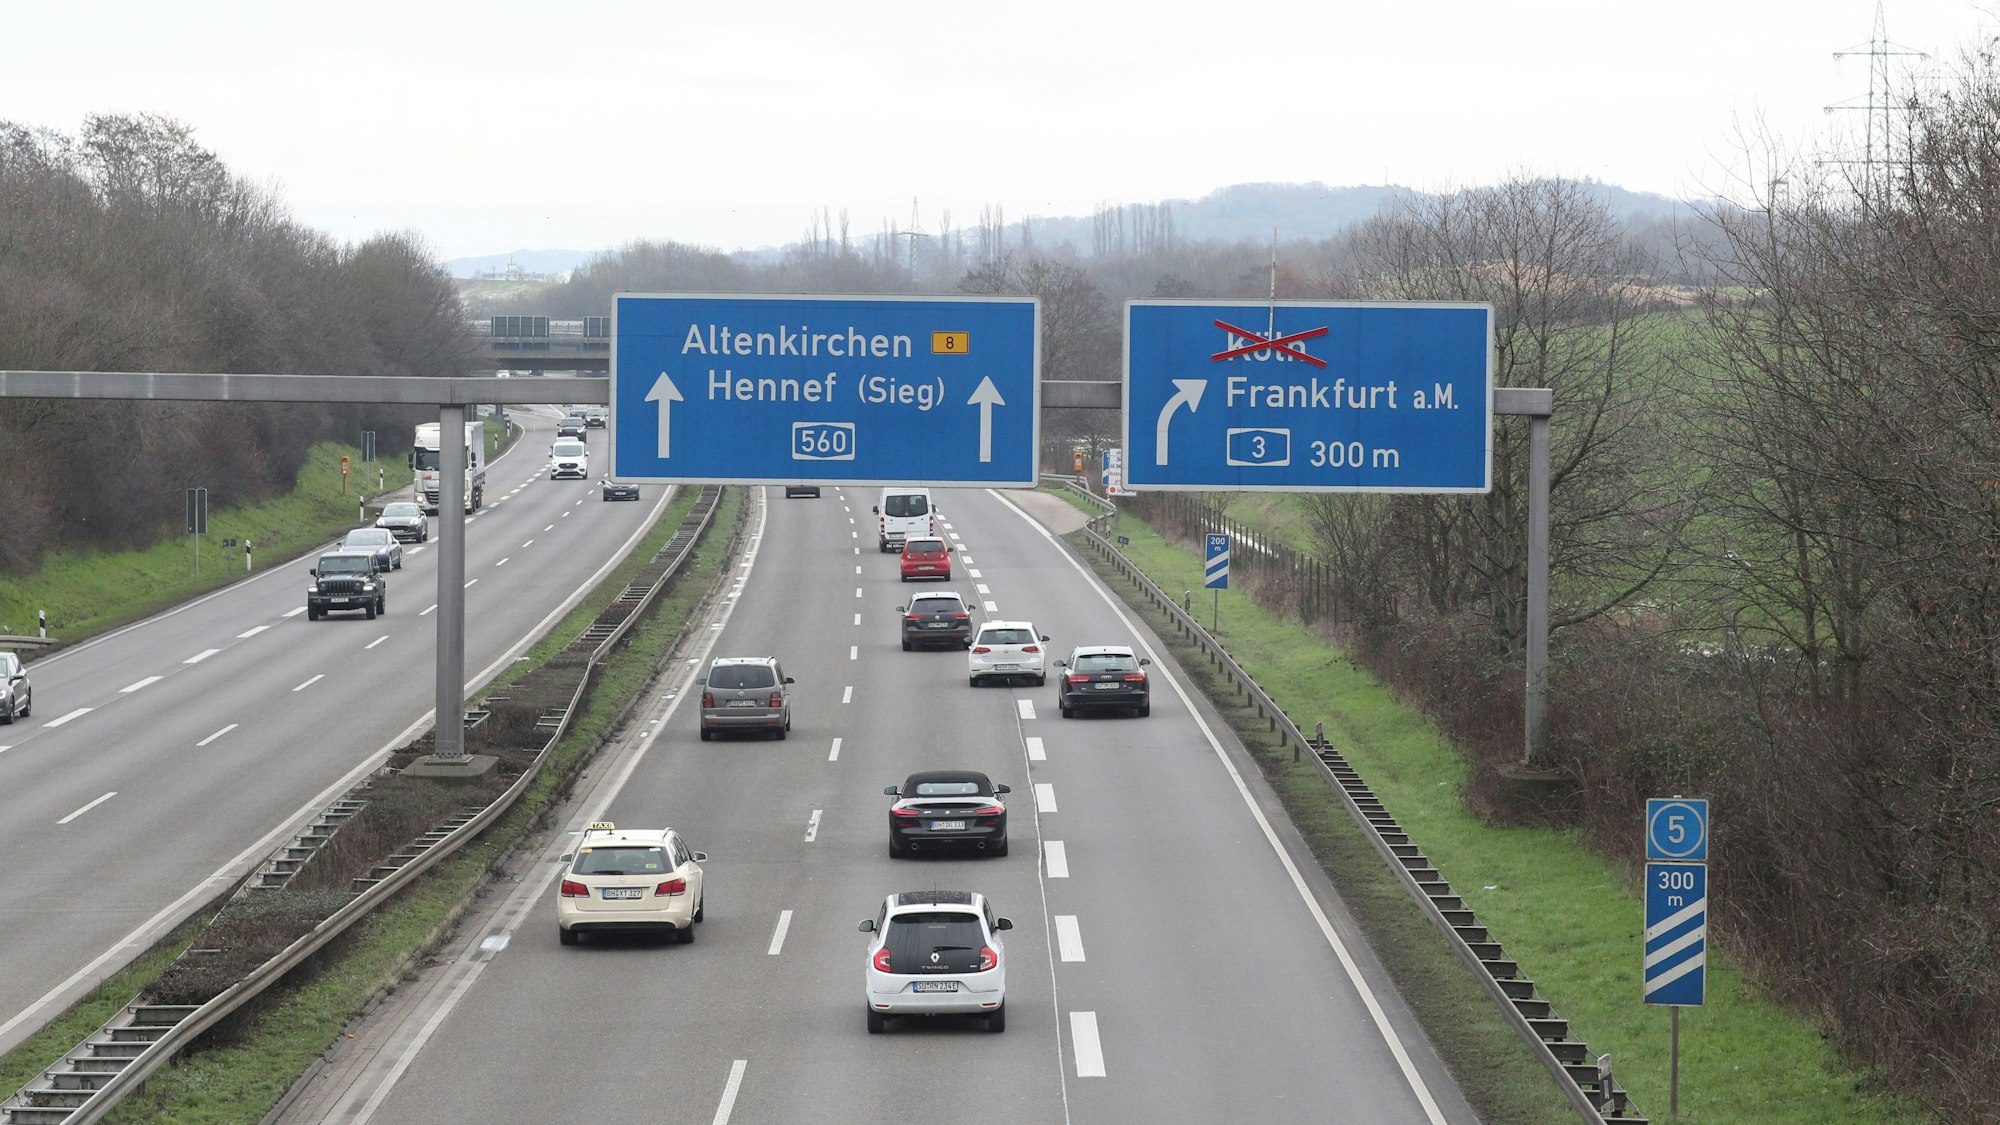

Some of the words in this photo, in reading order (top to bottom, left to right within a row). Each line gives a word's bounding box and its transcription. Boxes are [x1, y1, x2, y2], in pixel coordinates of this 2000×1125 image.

[682, 324, 912, 358] Altenkirchen
[946, 336, 954, 350] 8
[1227, 331, 1306, 361] Köln
[708, 369, 837, 402] Hennef
[858, 375, 945, 411] (Sieg)
[1227, 377, 1398, 409] Frankfurt
[1413, 382, 1459, 410] a.M.
[801, 430, 847, 453] 560
[1251, 436, 1266, 459] 3
[1310, 440, 1364, 468] 300
[1373, 448, 1399, 468] m
[1210, 537, 1226, 545] 200
[1668, 815, 1685, 844] 5
[1658, 871, 1694, 890] 300
[1668, 895, 1683, 906] m
